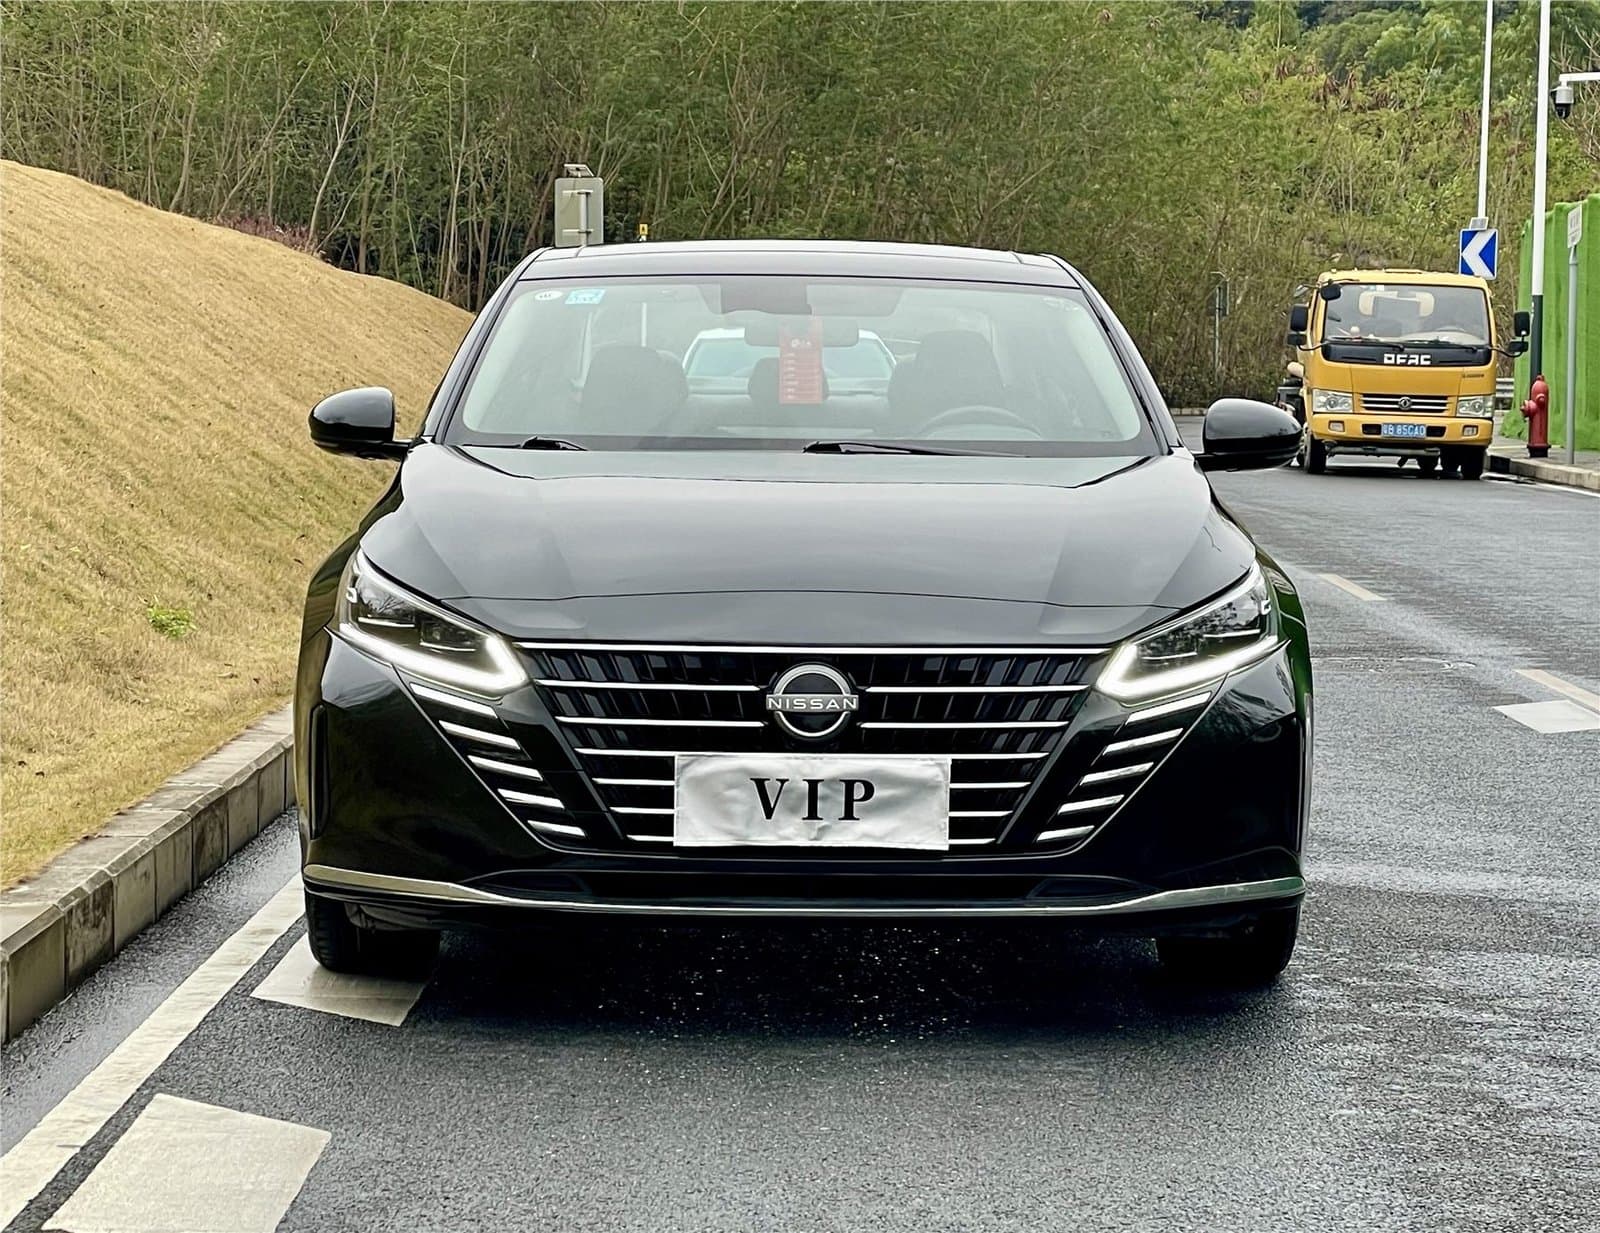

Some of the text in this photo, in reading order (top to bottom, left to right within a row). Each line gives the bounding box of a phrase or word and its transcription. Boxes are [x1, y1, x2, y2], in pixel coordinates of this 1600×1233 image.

[1384, 354, 1431, 365] DFAC
[768, 698, 857, 710] NISSAN
[750, 777, 875, 821] VIP
